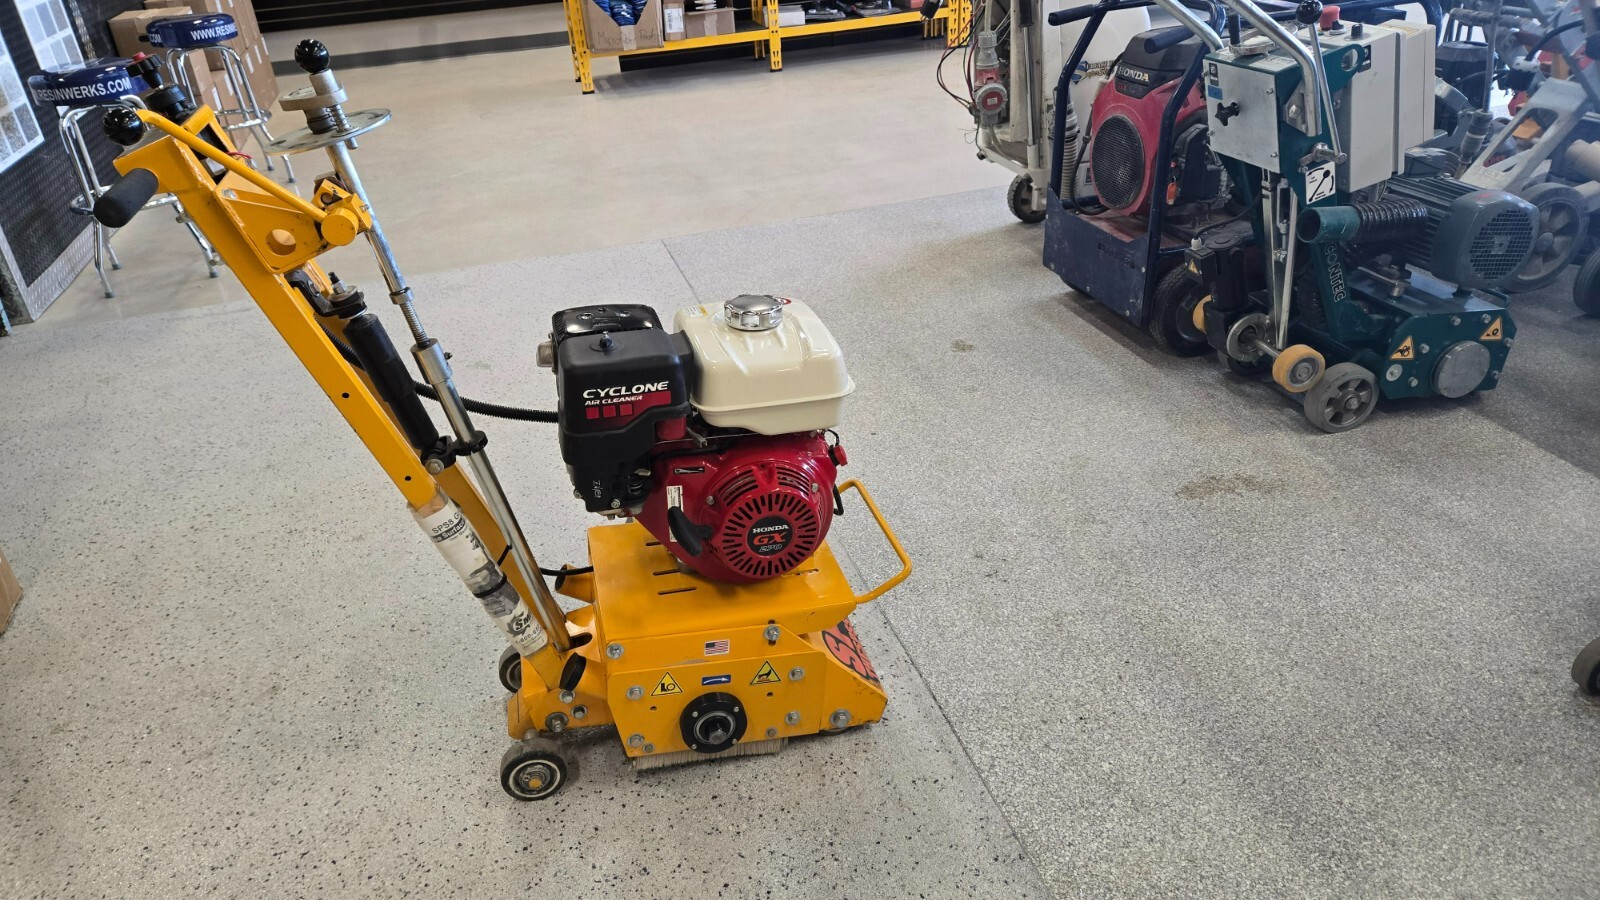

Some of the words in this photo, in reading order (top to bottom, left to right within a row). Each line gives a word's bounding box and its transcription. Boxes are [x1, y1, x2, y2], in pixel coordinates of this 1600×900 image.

[1117, 66, 1149, 82] HONDA
[583, 381, 669, 399] CYCLONE
[602, 395, 643, 404] CLEANER
[431, 518, 455, 534] SPS8
[752, 524, 789, 534] HONDA
[753, 532, 788, 545] GX
[759, 543, 783, 553] 270
